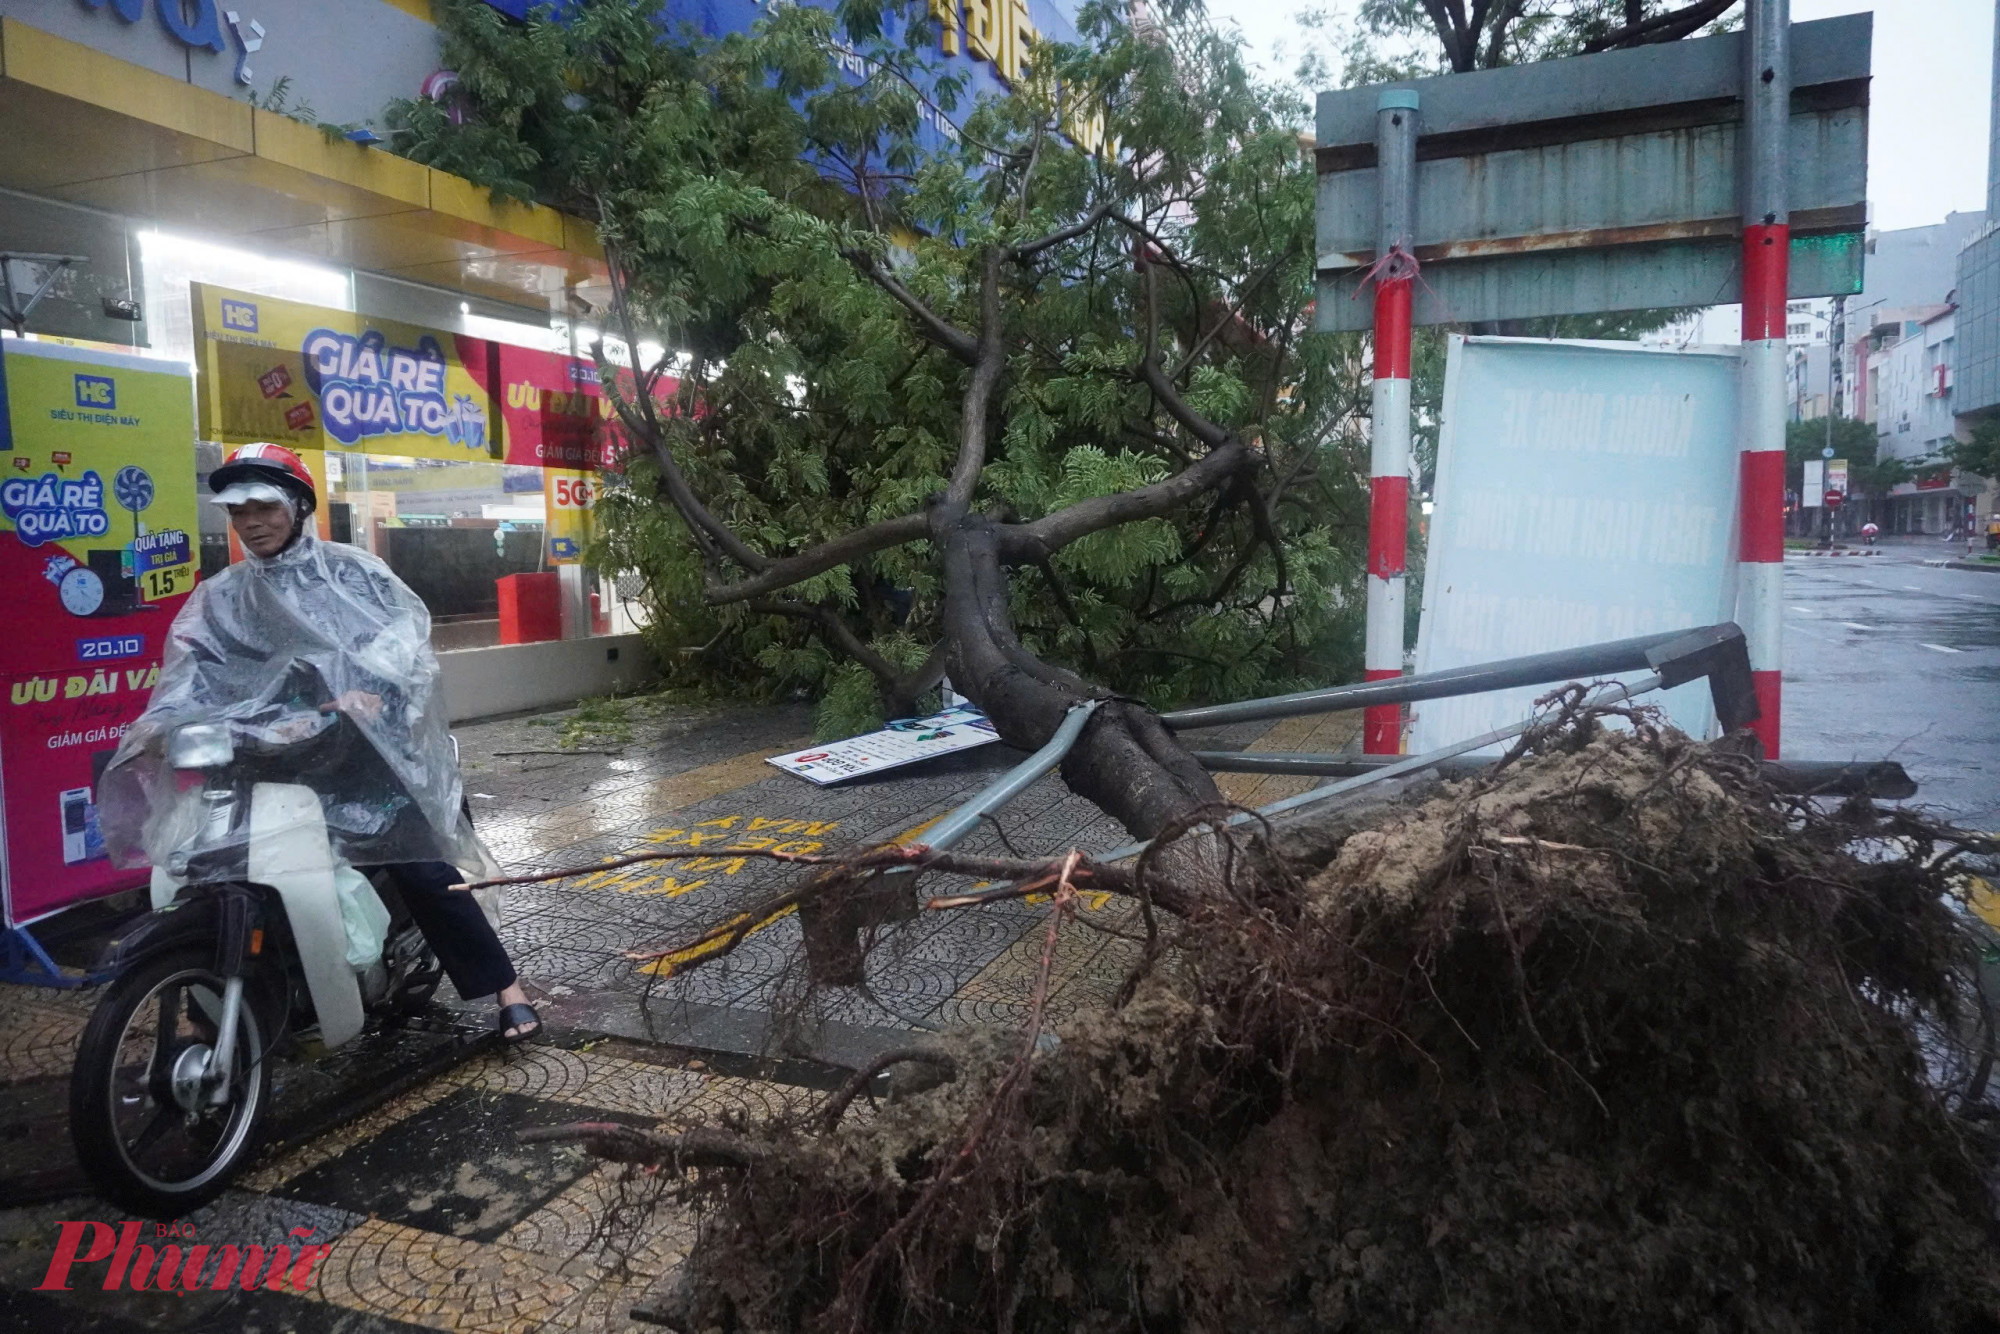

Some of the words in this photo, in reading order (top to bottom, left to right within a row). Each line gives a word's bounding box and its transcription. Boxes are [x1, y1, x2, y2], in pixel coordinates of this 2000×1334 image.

[224, 303, 255, 328] HC
[309, 336, 380, 384] GIÁ
[390, 348, 442, 393] RẺ
[78, 379, 112, 404] HC
[507, 380, 541, 411] ƯU
[50, 408, 74, 420] SIÊU
[77, 412, 93, 424] THỊ
[95, 413, 118, 426] ĐIỆN
[120, 415, 140, 427] MÁY
[326, 385, 397, 425] QUÀ
[404, 397, 445, 429] TO
[4, 478, 56, 506] GIÁ
[63, 477, 100, 508] RẺ
[20, 508, 71, 536] QUÀ
[76, 514, 106, 532] TO
[134, 531, 157, 553] QUÀ
[158, 528, 184, 550] TẶNG
[151, 553, 163, 566] TRỊ
[164, 548, 178, 563] GIÁ
[149, 569, 174, 597] 1.5
[82, 639, 139, 658] 20.10
[10, 676, 58, 706] ƯU
[64, 669, 120, 699] ĐÃI
[47, 730, 82, 749] GIẢM
[85, 726, 107, 743] GIÁ
